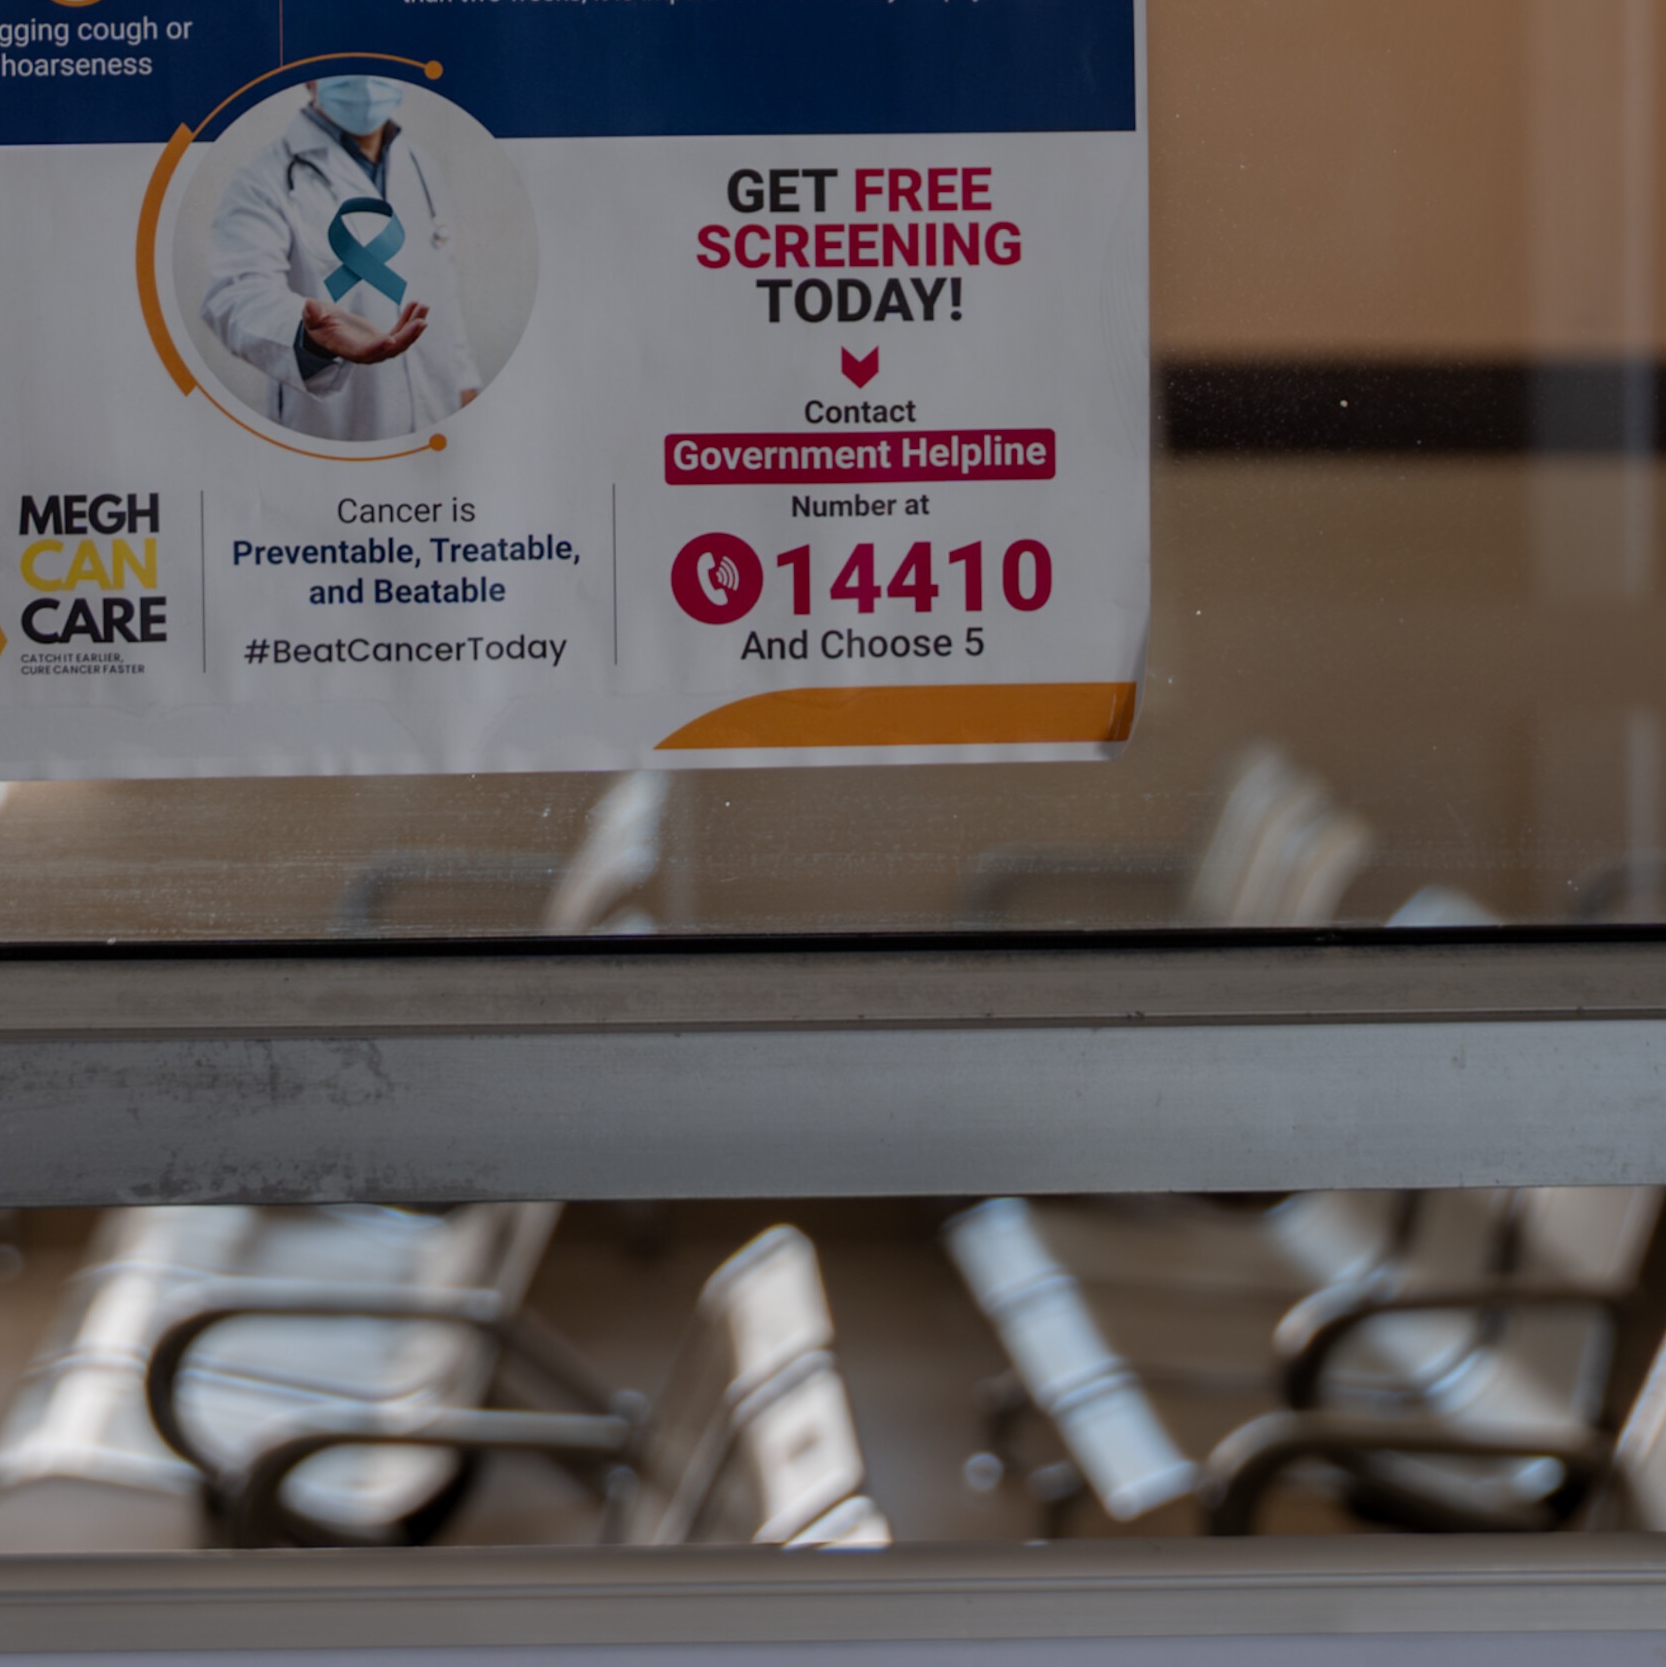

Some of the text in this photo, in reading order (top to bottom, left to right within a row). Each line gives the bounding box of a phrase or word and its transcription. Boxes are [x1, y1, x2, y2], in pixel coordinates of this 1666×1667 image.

[78, 16, 157, 46] cough
[166, 21, 193, 40] or
[1, 53, 152, 77] hoarseness
[727, 167, 991, 213] GET FREE
[697, 222, 1021, 269] SCREENING
[756, 277, 962, 323] TODAY!
[805, 400, 916, 424] Contact
[674, 435, 1046, 474] Government Helpline
[19, 493, 159, 535] MEGH
[338, 497, 475, 524] Cancer is
[792, 494, 929, 517] Number at
[20, 538, 156, 592] CAN
[234, 534, 579, 568] Preventable, Treatable,
[310, 577, 505, 605] and Beatable
[777, 539, 1052, 615] 14410
[21, 597, 167, 644] CARE
[244, 634, 567, 667] #BeatCancerToday
[741, 627, 984, 660] And Choose 5
[20, 664, 146, 675] CURE CANCER FASTER
